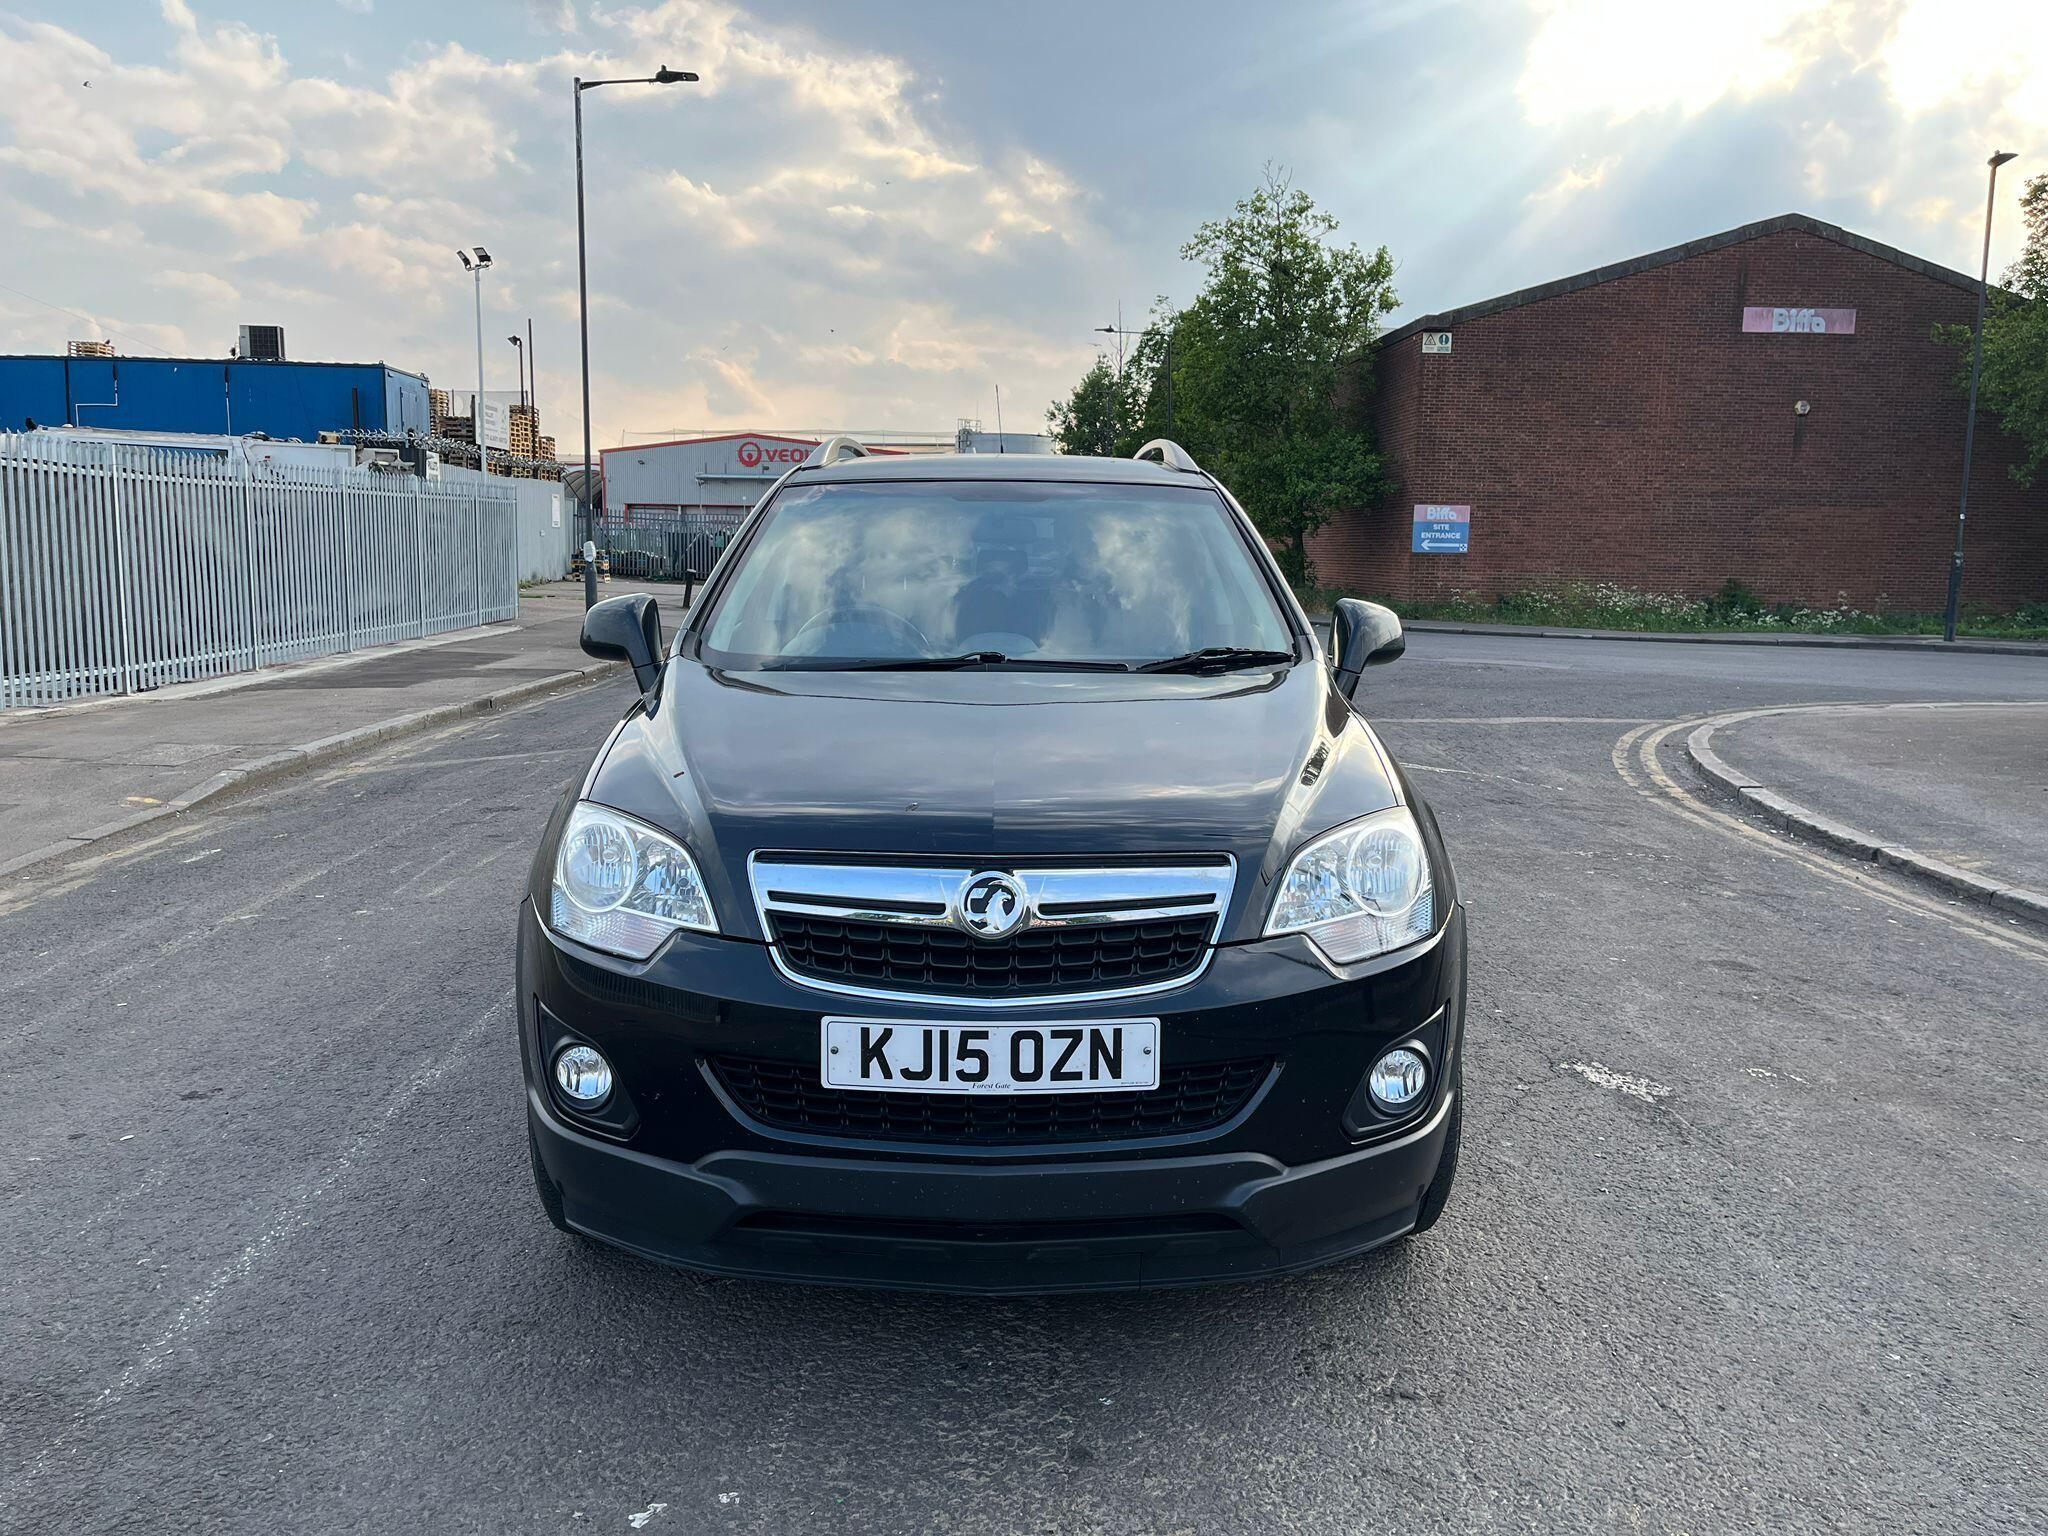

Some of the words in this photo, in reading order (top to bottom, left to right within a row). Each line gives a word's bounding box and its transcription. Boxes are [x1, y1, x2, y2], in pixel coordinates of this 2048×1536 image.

[1773, 308, 1826, 333] Biffa
[1426, 506, 1457, 520] Biffa
[1433, 523, 1449, 531] SITE
[1421, 531, 1461, 539] ENTRANCE
[860, 1027, 989, 1083] KJ15
[1010, 1028, 1123, 1083] OZN
